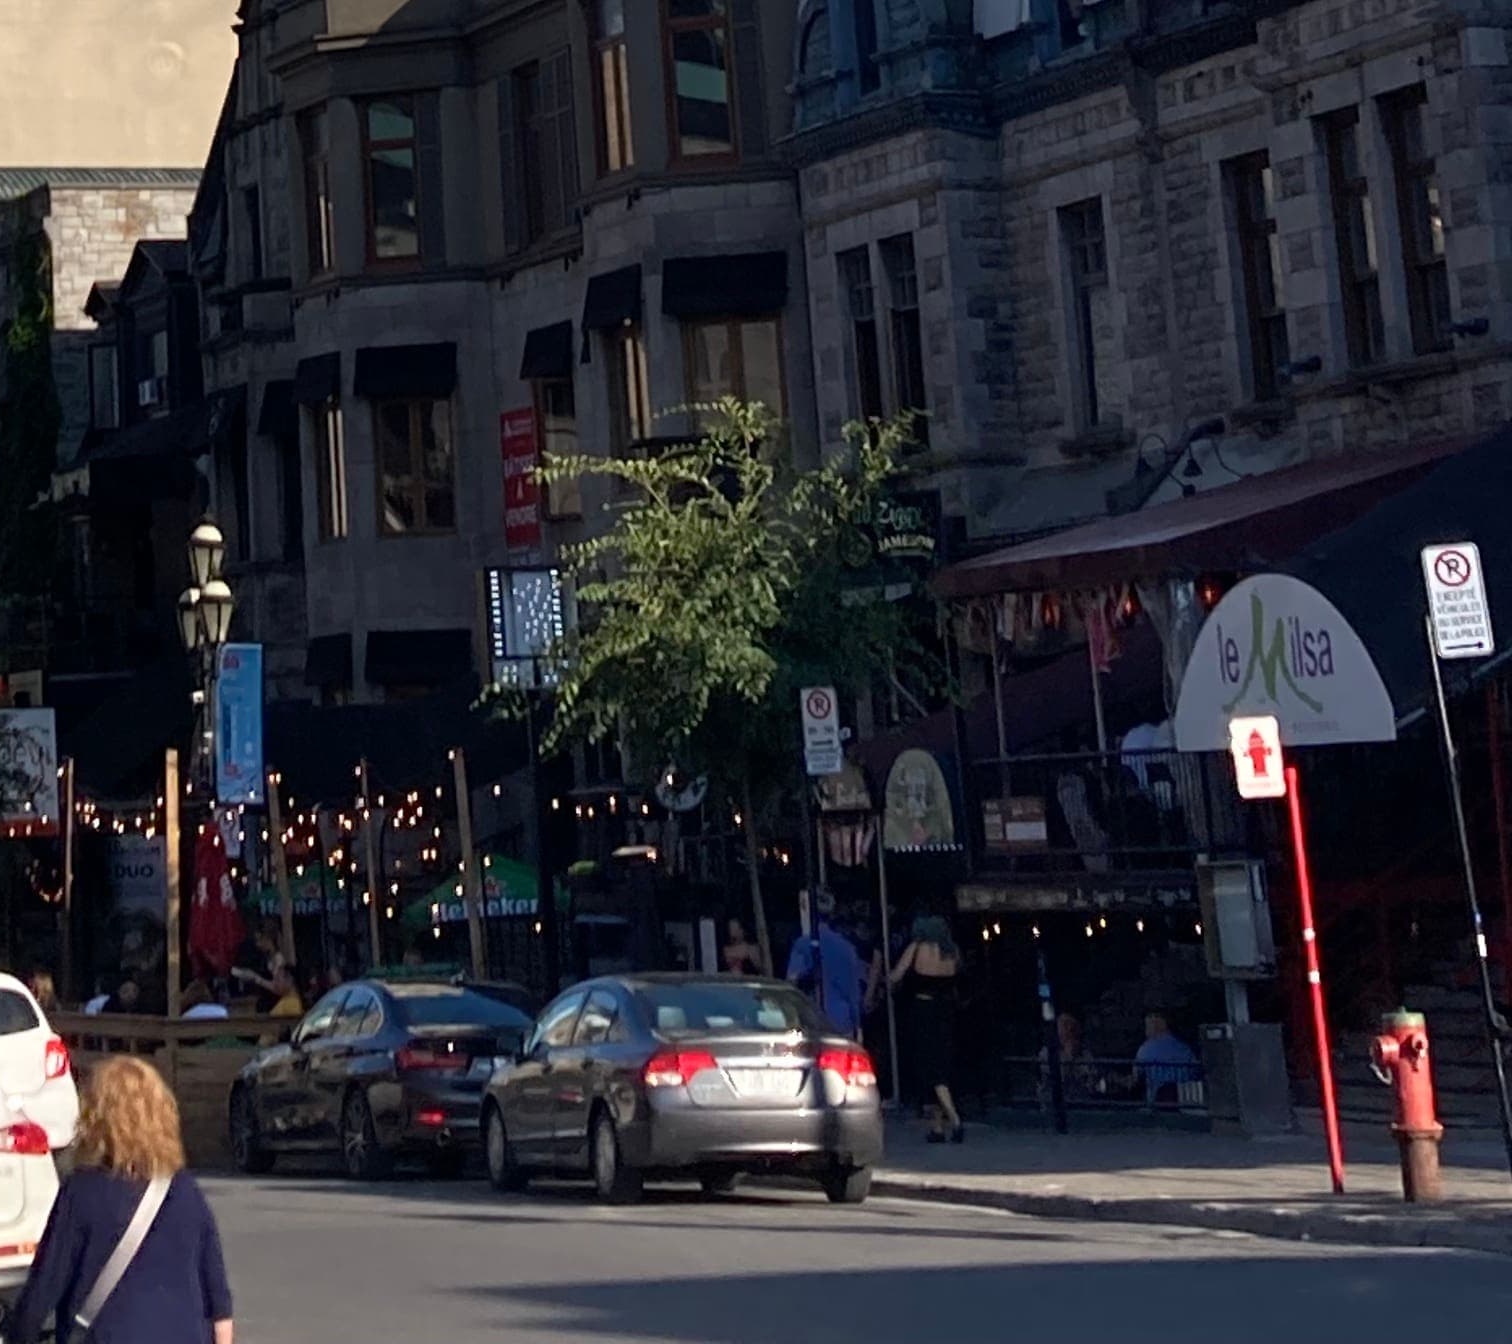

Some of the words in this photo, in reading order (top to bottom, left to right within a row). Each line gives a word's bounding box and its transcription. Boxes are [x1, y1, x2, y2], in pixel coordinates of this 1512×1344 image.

[1217, 624, 1240, 683] le
[1221, 591, 1334, 713] Milsa
[115, 863, 154, 879] DUO
